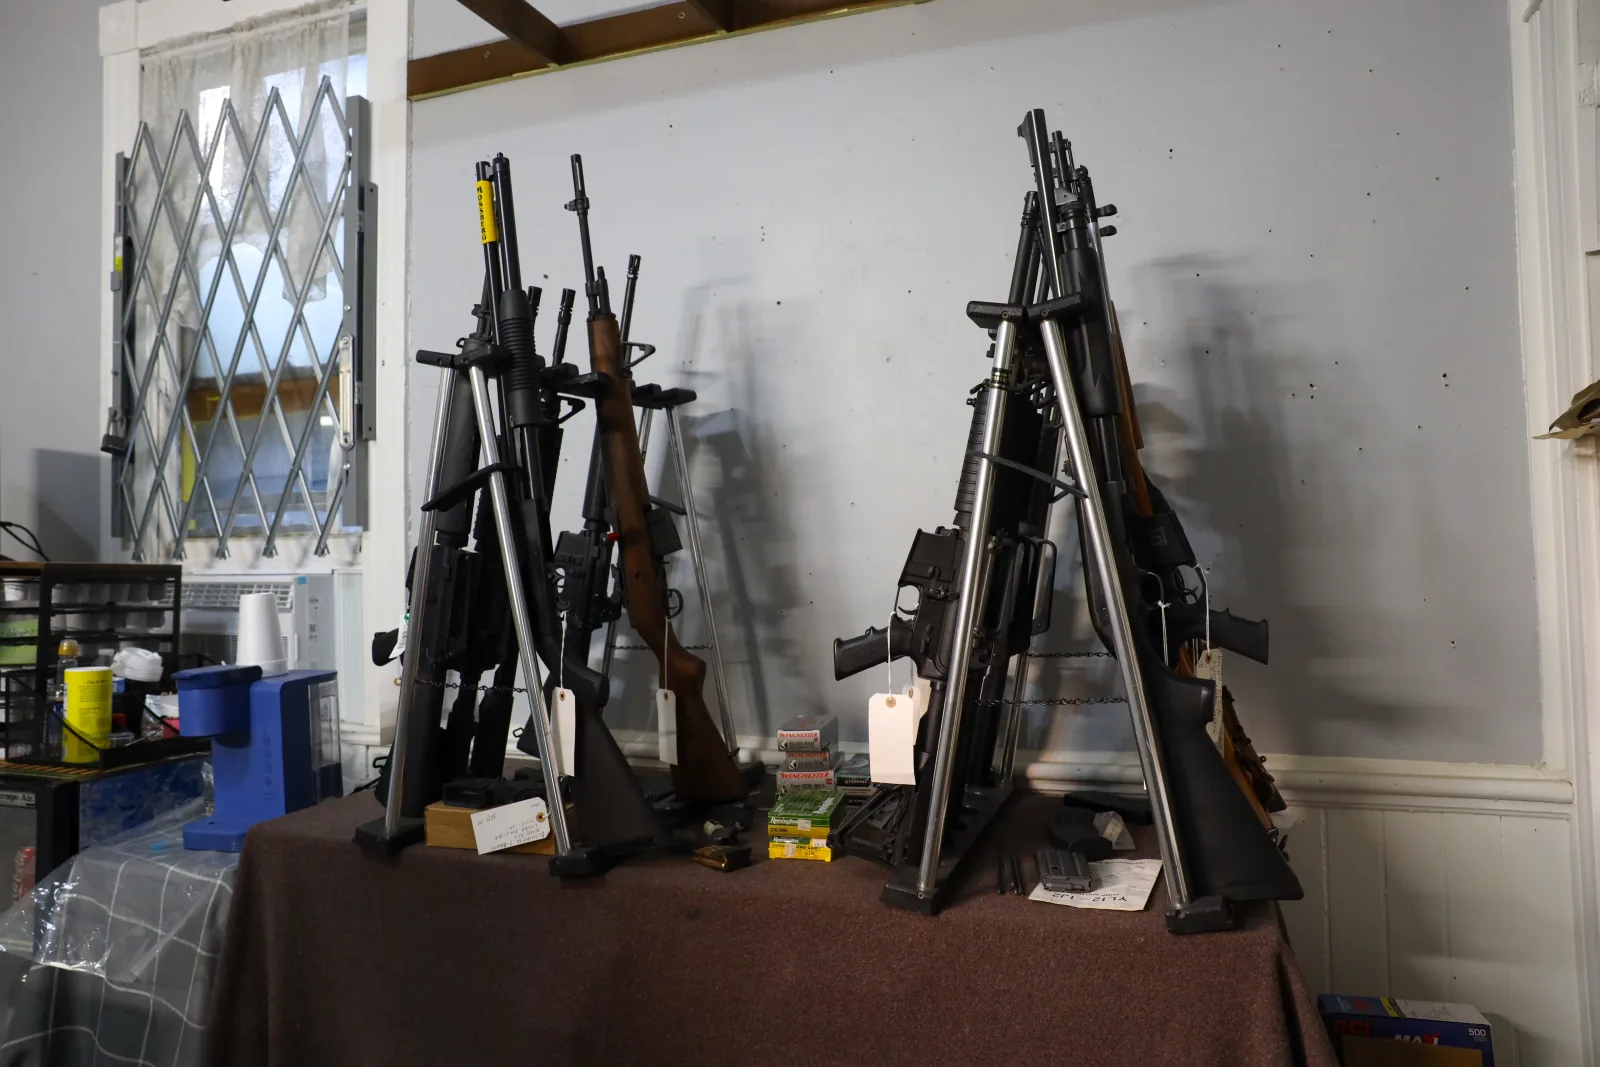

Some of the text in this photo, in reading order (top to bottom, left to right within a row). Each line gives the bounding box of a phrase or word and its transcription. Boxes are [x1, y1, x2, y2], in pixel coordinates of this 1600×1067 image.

[476, 186, 487, 240] MOSSBERG
[780, 771, 830, 779] WINCHESTER
[1333, 1020, 1372, 1035] CCI
[1468, 1028, 1487, 1036] 500
